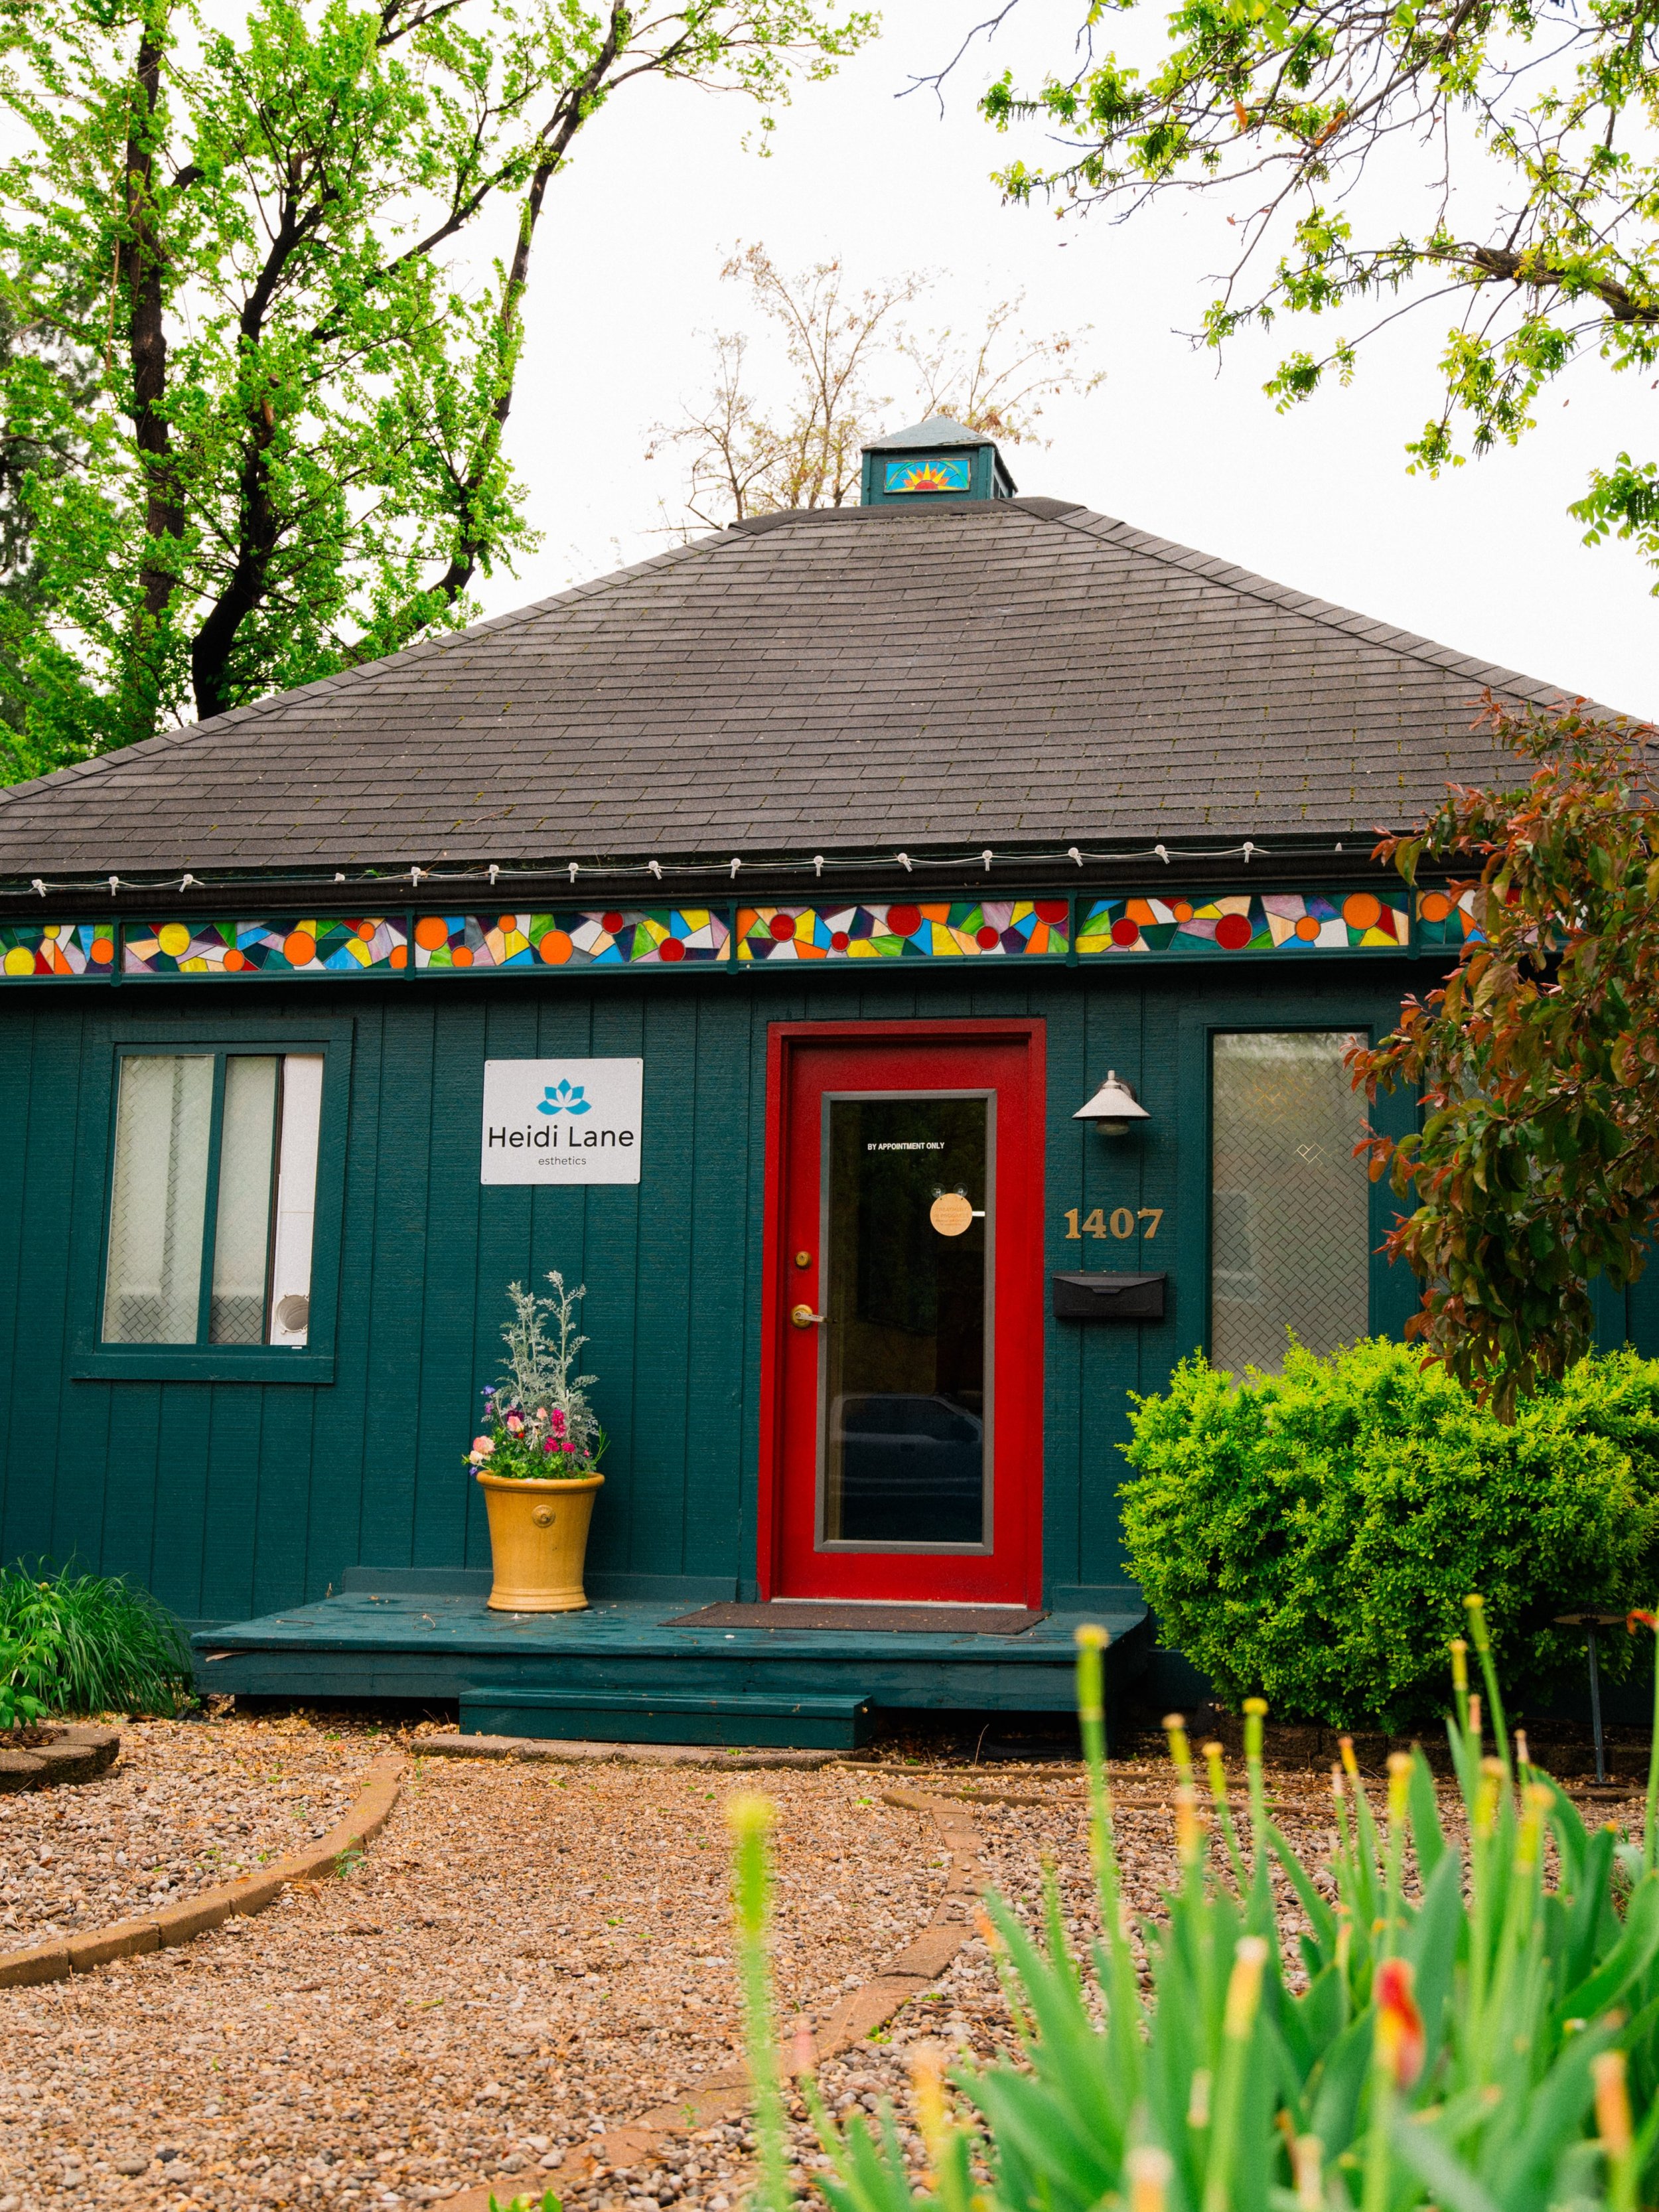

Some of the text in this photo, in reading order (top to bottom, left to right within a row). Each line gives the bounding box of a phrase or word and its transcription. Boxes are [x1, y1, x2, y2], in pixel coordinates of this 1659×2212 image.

[489, 1125, 634, 1147] Heidi Lane
[539, 1156, 586, 1165] esthetics
[1064, 1208, 1164, 1239] 1407
